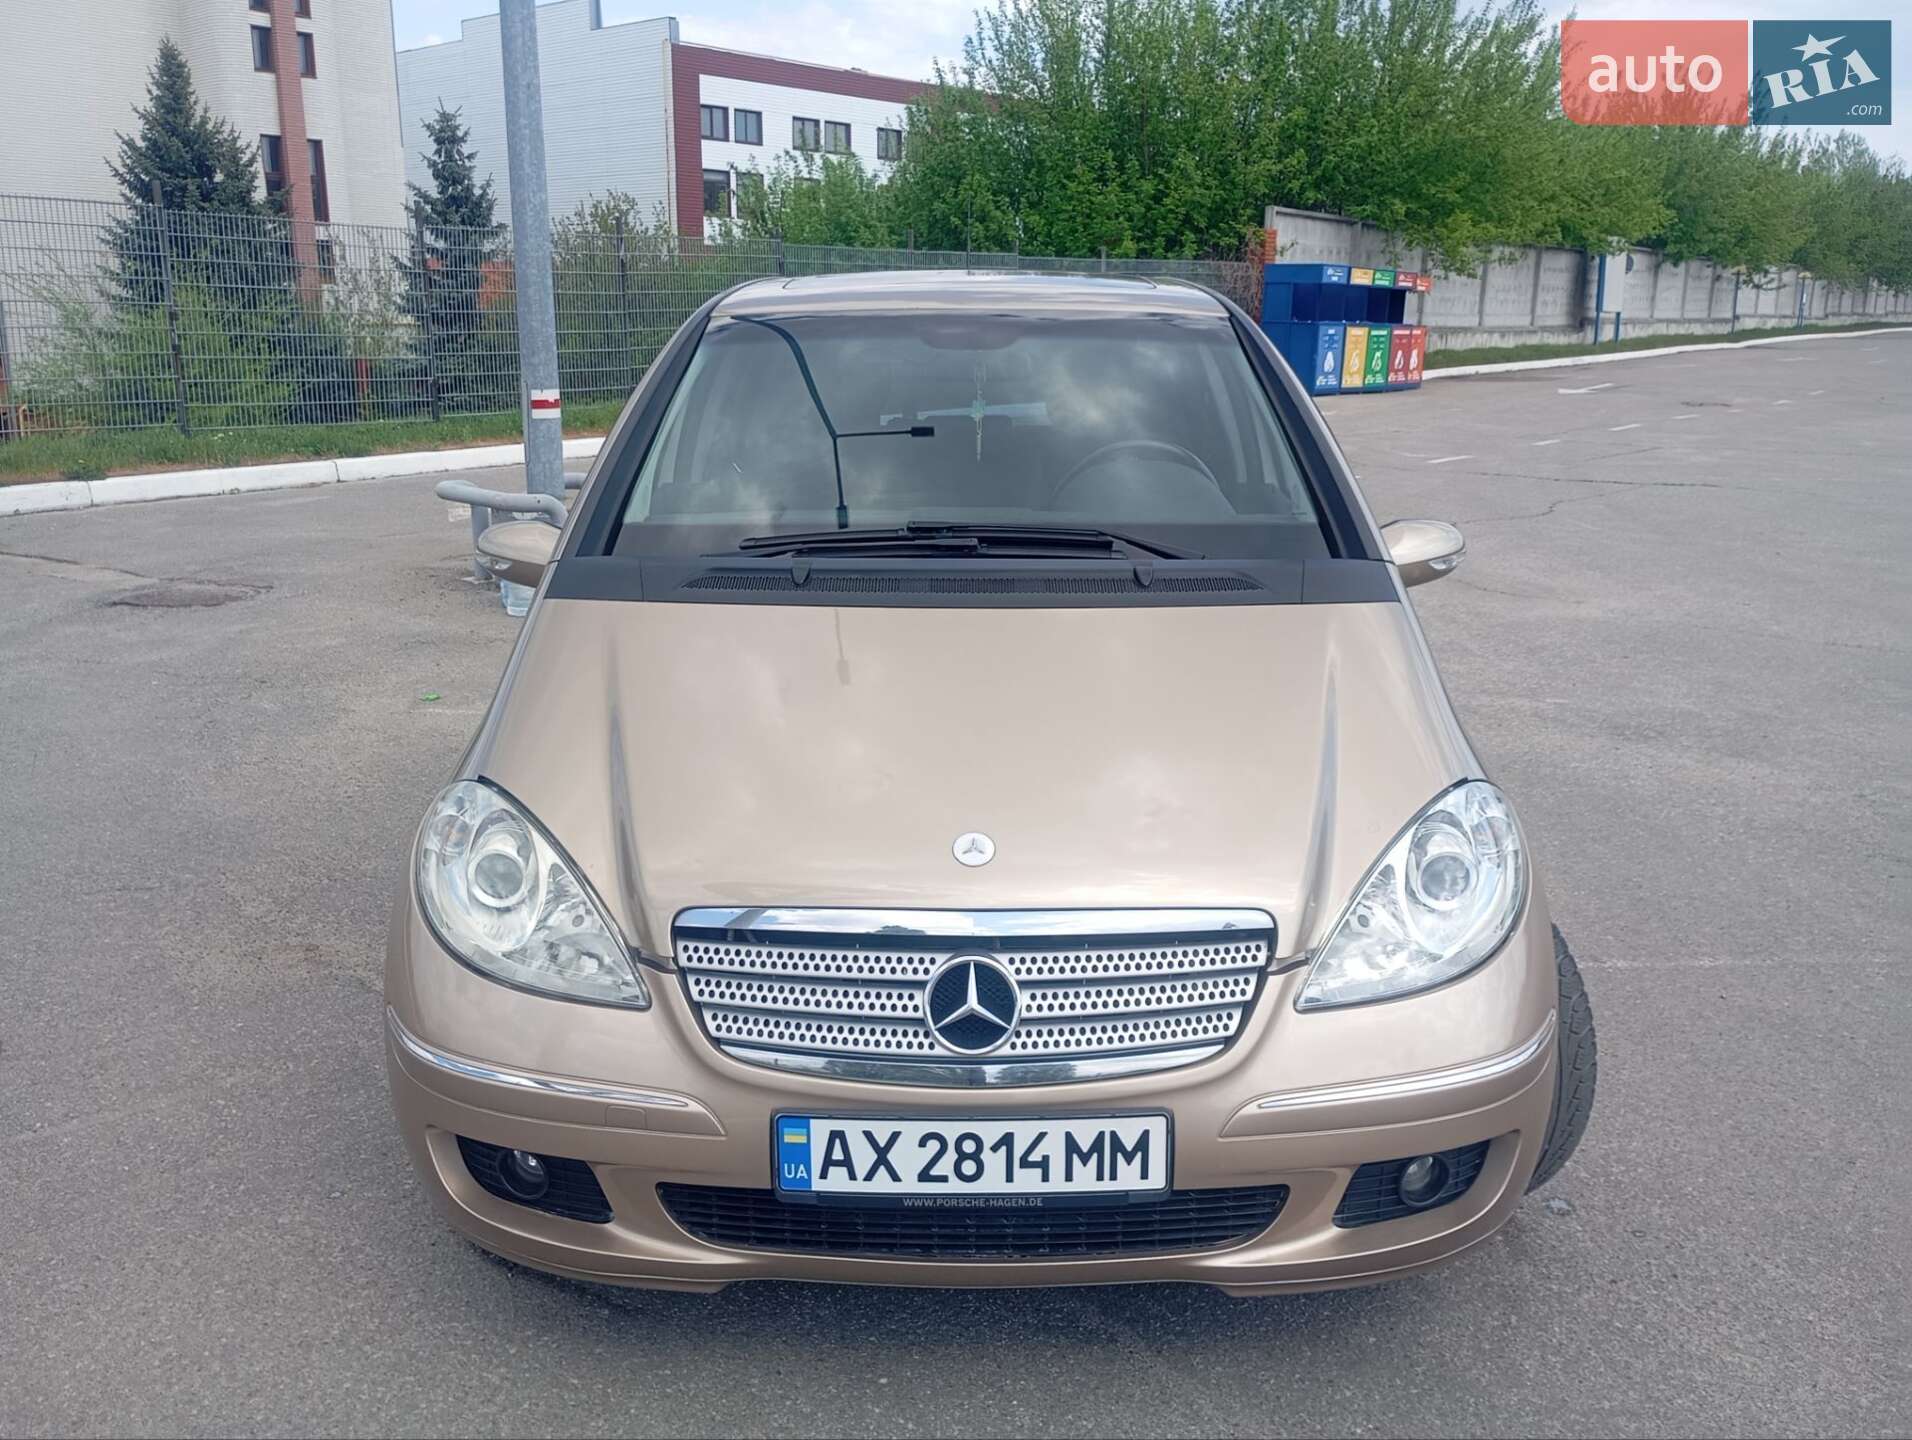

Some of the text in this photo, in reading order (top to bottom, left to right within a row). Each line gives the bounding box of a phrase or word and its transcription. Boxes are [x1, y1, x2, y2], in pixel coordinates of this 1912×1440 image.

[818, 1129, 1151, 1184] AX 2814 MM
[784, 1162, 808, 1180] UA
[902, 1197, 1044, 1208] WWW.PORSCHE-HAGEN.DE
